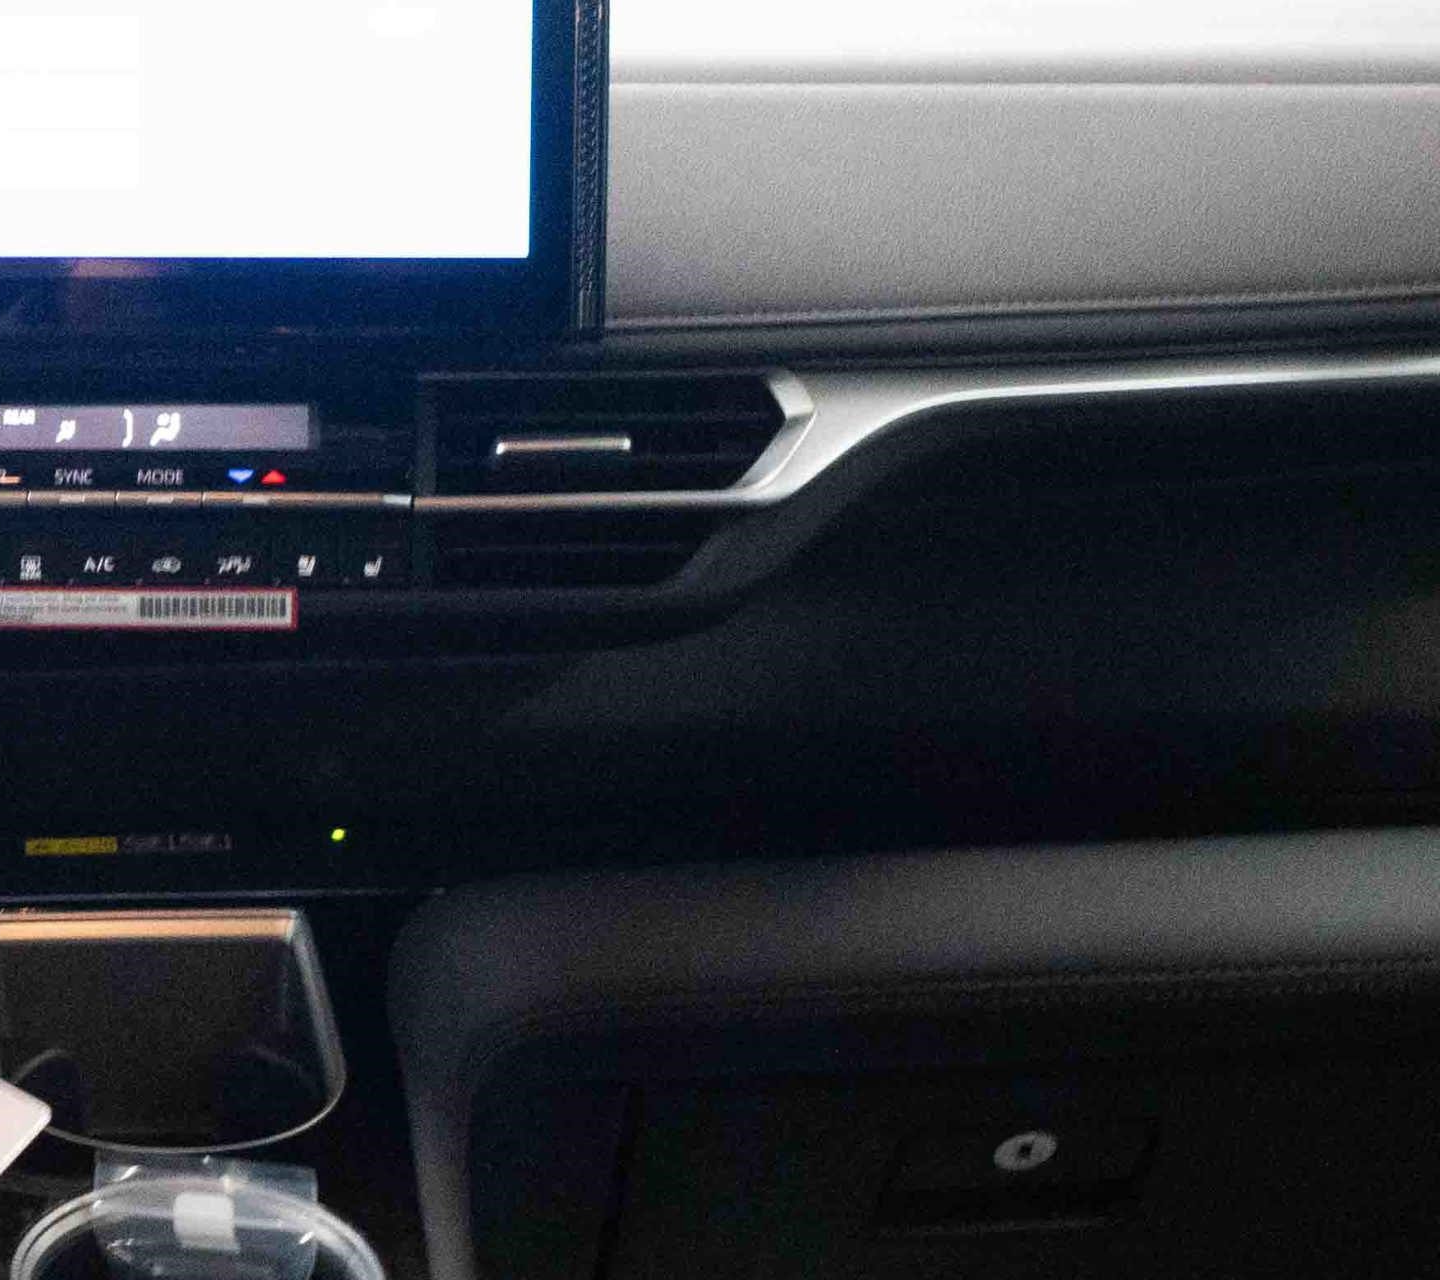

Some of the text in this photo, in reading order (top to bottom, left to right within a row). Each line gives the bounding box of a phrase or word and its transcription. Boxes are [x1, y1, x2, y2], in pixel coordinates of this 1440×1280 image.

[54, 469, 93, 485] SYNC
[137, 469, 185, 485] MODE
[83, 556, 116, 572] A/C
